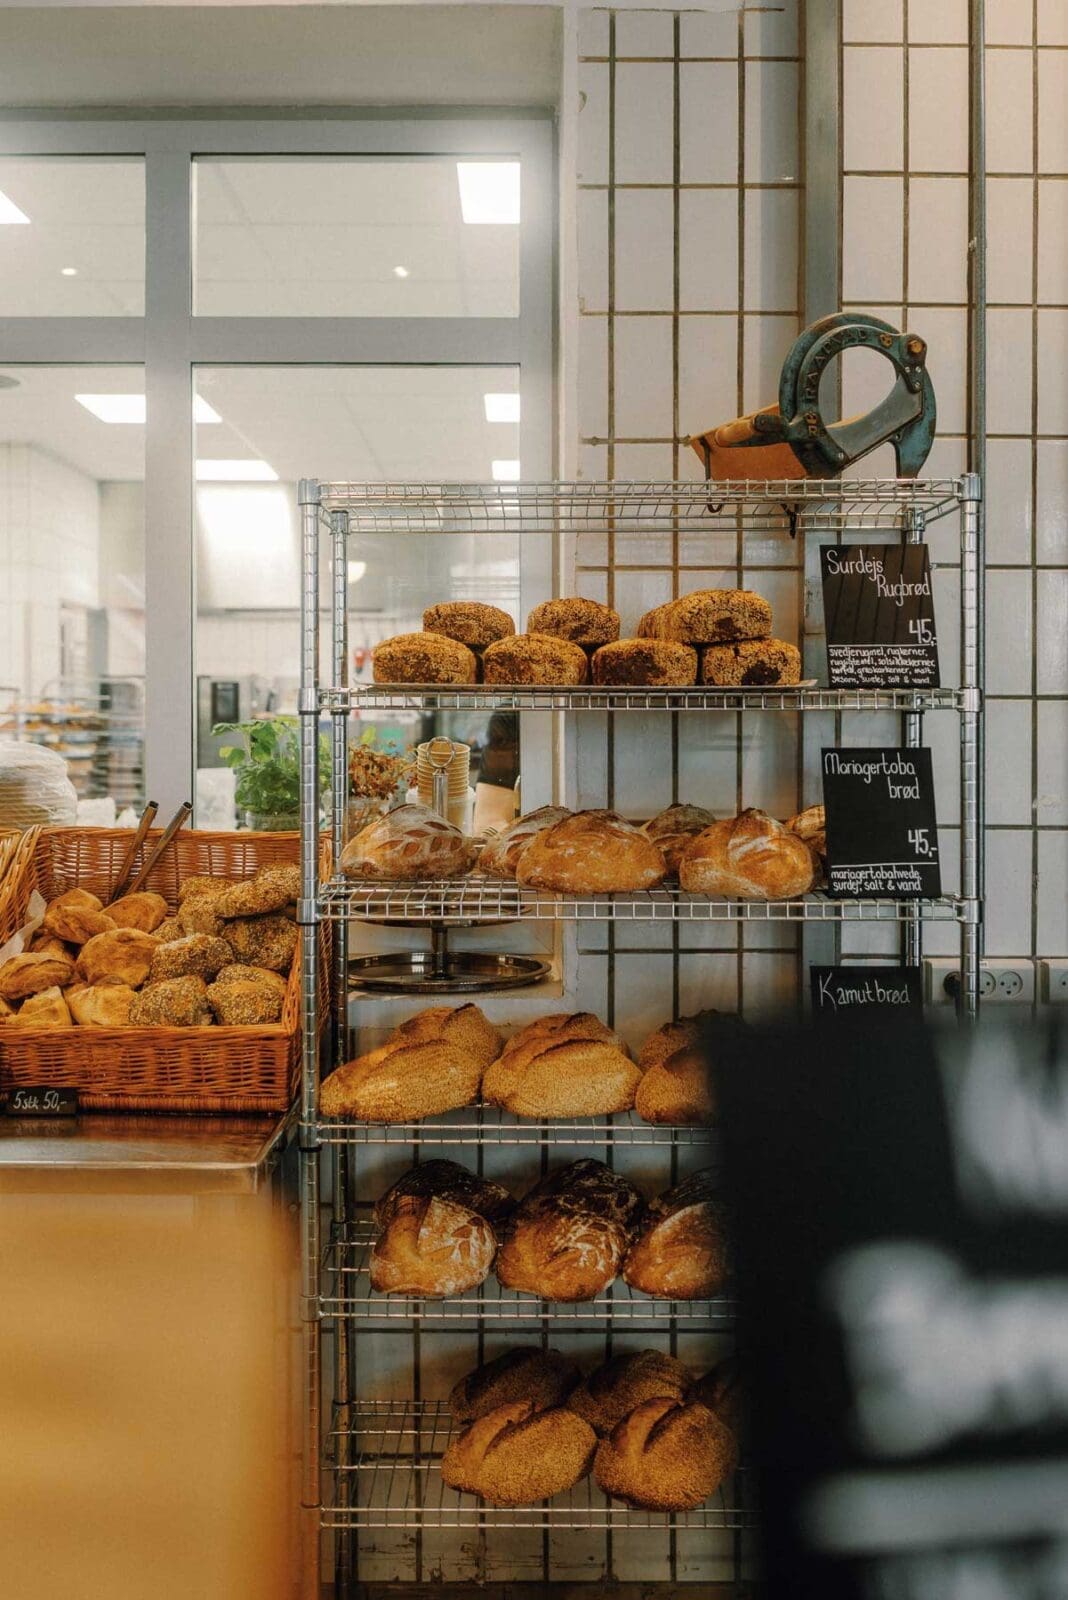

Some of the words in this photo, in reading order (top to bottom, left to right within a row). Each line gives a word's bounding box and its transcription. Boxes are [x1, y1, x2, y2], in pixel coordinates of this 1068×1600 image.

[826, 549, 884, 582] Surdejs
[877, 572, 930, 607] Rugbrød
[824, 752, 916, 784] Mariagertoba
[887, 775, 920, 799] brød
[908, 829, 937, 857] 45,-
[864, 880, 885, 891] salt
[887, 880, 896, 891] &
[819, 972, 911, 1013] Kamutbrød
